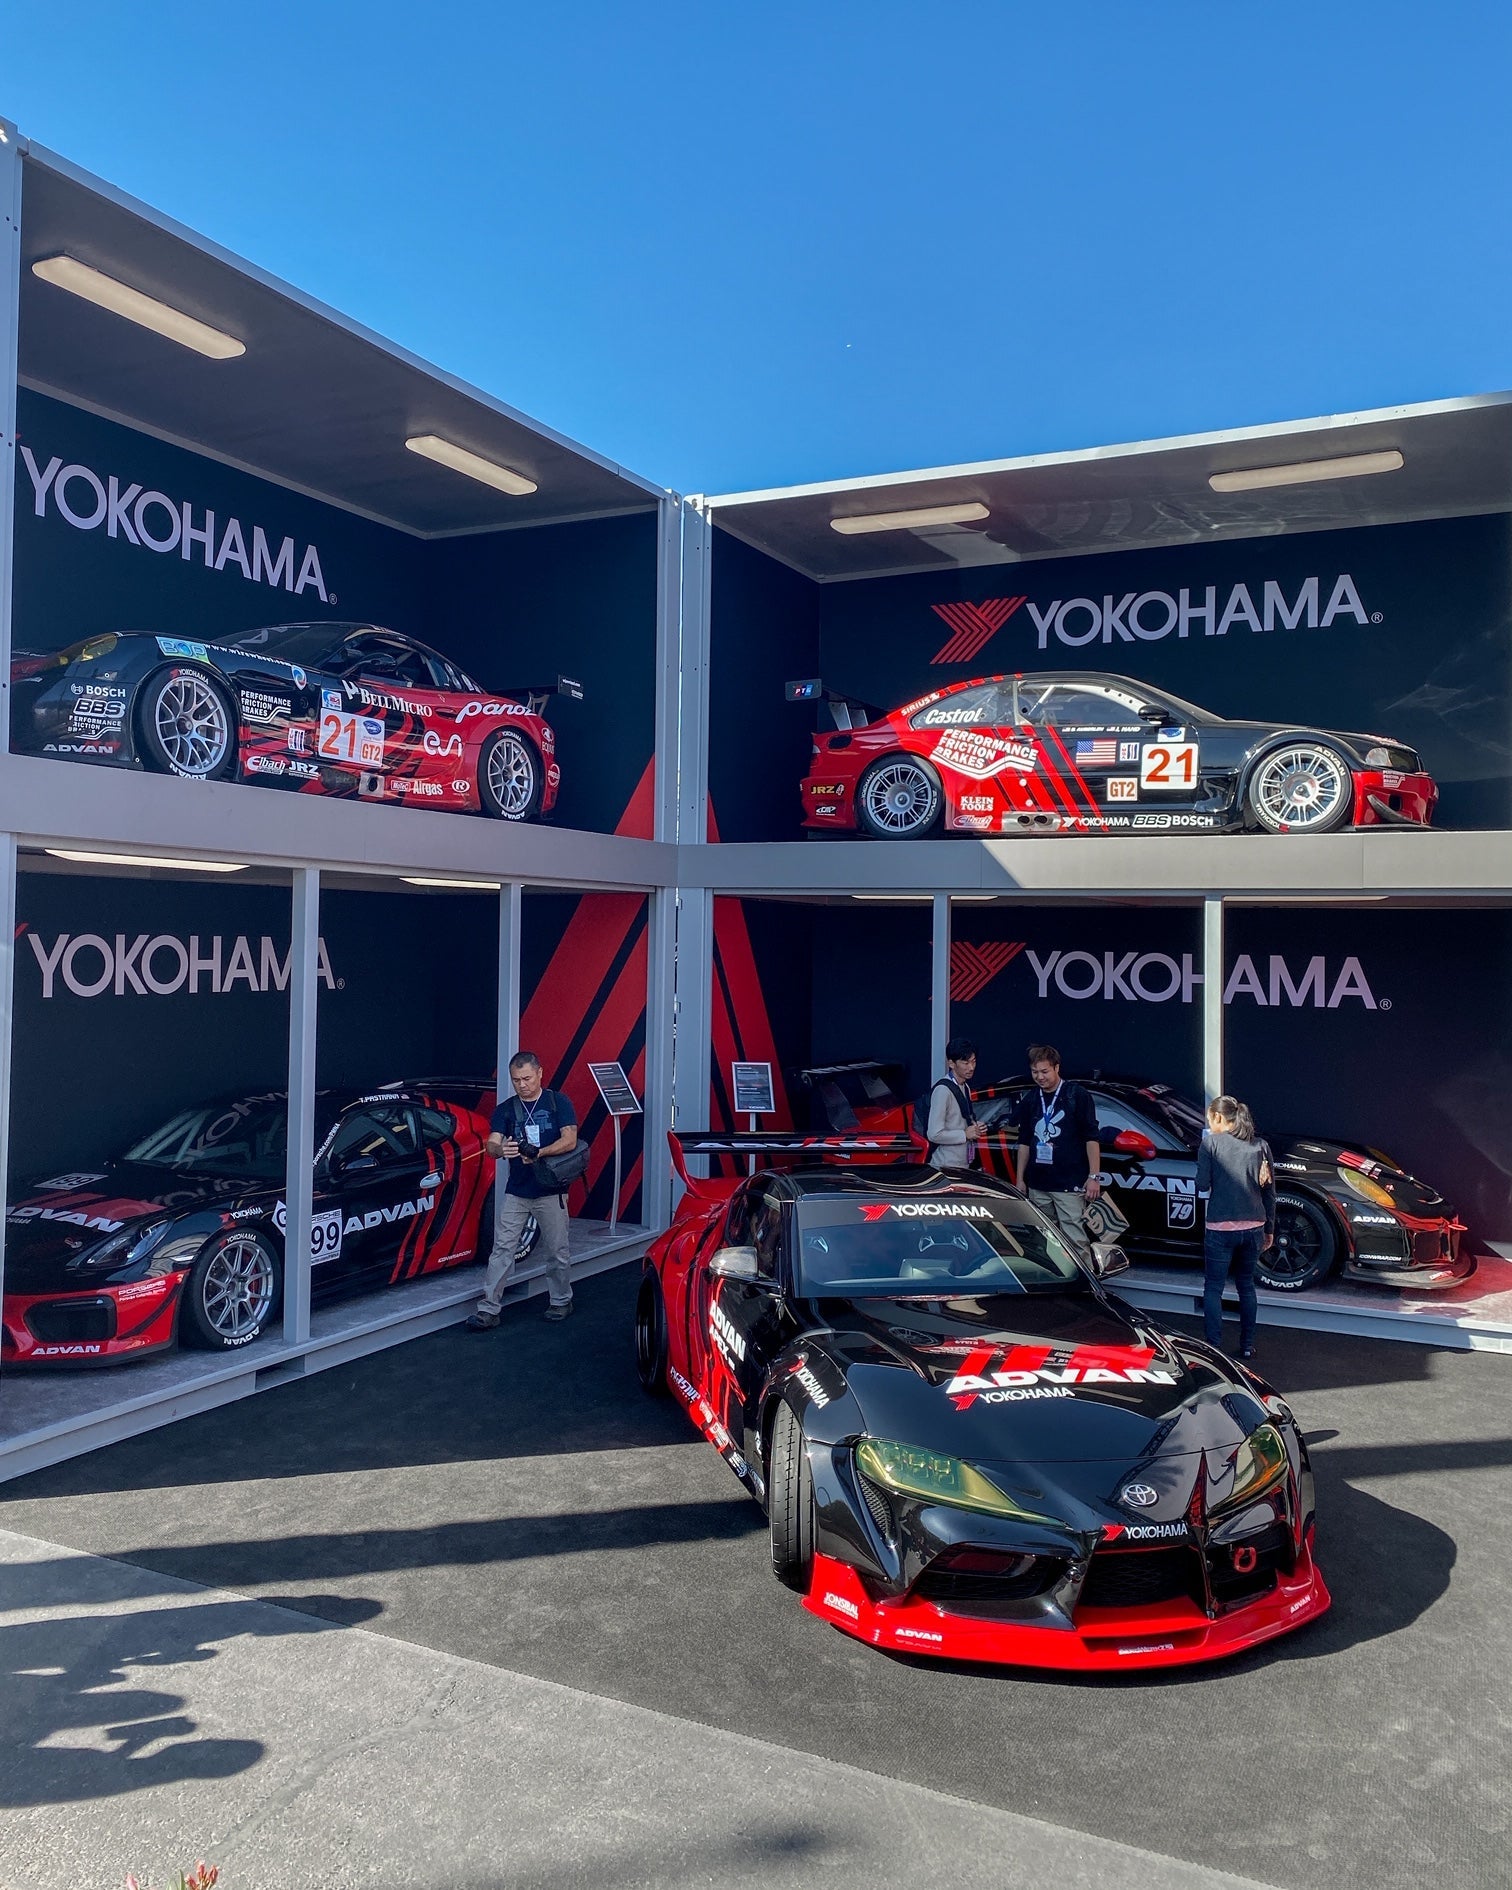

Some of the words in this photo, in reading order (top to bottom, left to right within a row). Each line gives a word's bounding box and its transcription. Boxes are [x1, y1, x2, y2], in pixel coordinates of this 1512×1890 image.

[20, 445, 329, 603] YOKOHAMA
[1026, 574, 1368, 649] YOKOHAMA
[178, 668, 209, 685] YOKOHAMA
[86, 685, 126, 698] BOSCH
[241, 690, 292, 707] PERFORMANCE
[73, 697, 126, 718] BBS
[925, 708, 983, 725] Castrol
[321, 714, 356, 758] 21
[43, 743, 114, 753] ADVAN
[361, 743, 381, 762] GT2
[938, 736, 997, 760] FRICTION
[943, 729, 1039, 761] PERFORMANCE
[932, 745, 985, 769] BRAKES
[1145, 748, 1194, 782] 21
[1314, 746, 1346, 777] ADVAN
[289, 760, 319, 775] JRZ
[413, 781, 444, 795] Airgas
[811, 785, 835, 795] JRZ
[1110, 782, 1135, 798] GT2
[960, 796, 994, 804] KLEIN
[960, 803, 994, 811] TOOLS
[1077, 816, 1130, 827] YOKOHAMA
[1132, 814, 1172, 828] BBS
[1172, 815, 1214, 826] BOSCH
[1098, 1170, 1196, 1194] DVAN
[230, 1206, 263, 1220] YOKOHAMA
[312, 1209, 342, 1223] RSCHE
[343, 1195, 434, 1235] ADVAN
[890, 1203, 994, 1219] YOKOHAMA
[1170, 1203, 1194, 1220] 79
[1353, 1215, 1396, 1225] ADVAN
[226, 1232, 257, 1242] YOKOHAMA
[311, 1221, 340, 1255] 99
[1260, 1275, 1304, 1289] ADVAN
[224, 1326, 261, 1346] ADVAN
[709, 1300, 746, 1362] ADVAN
[31, 1345, 101, 1356] ADVAN
[796, 1365, 831, 1410] YOKOHAMA
[946, 1369, 1178, 1394] ADVAN
[980, 1387, 1076, 1404] YOKOHAMA
[1125, 1523, 1188, 1539] YOKOHAMA
[1290, 1596, 1312, 1614] ADVAN
[895, 1628, 943, 1642] ADVAN
